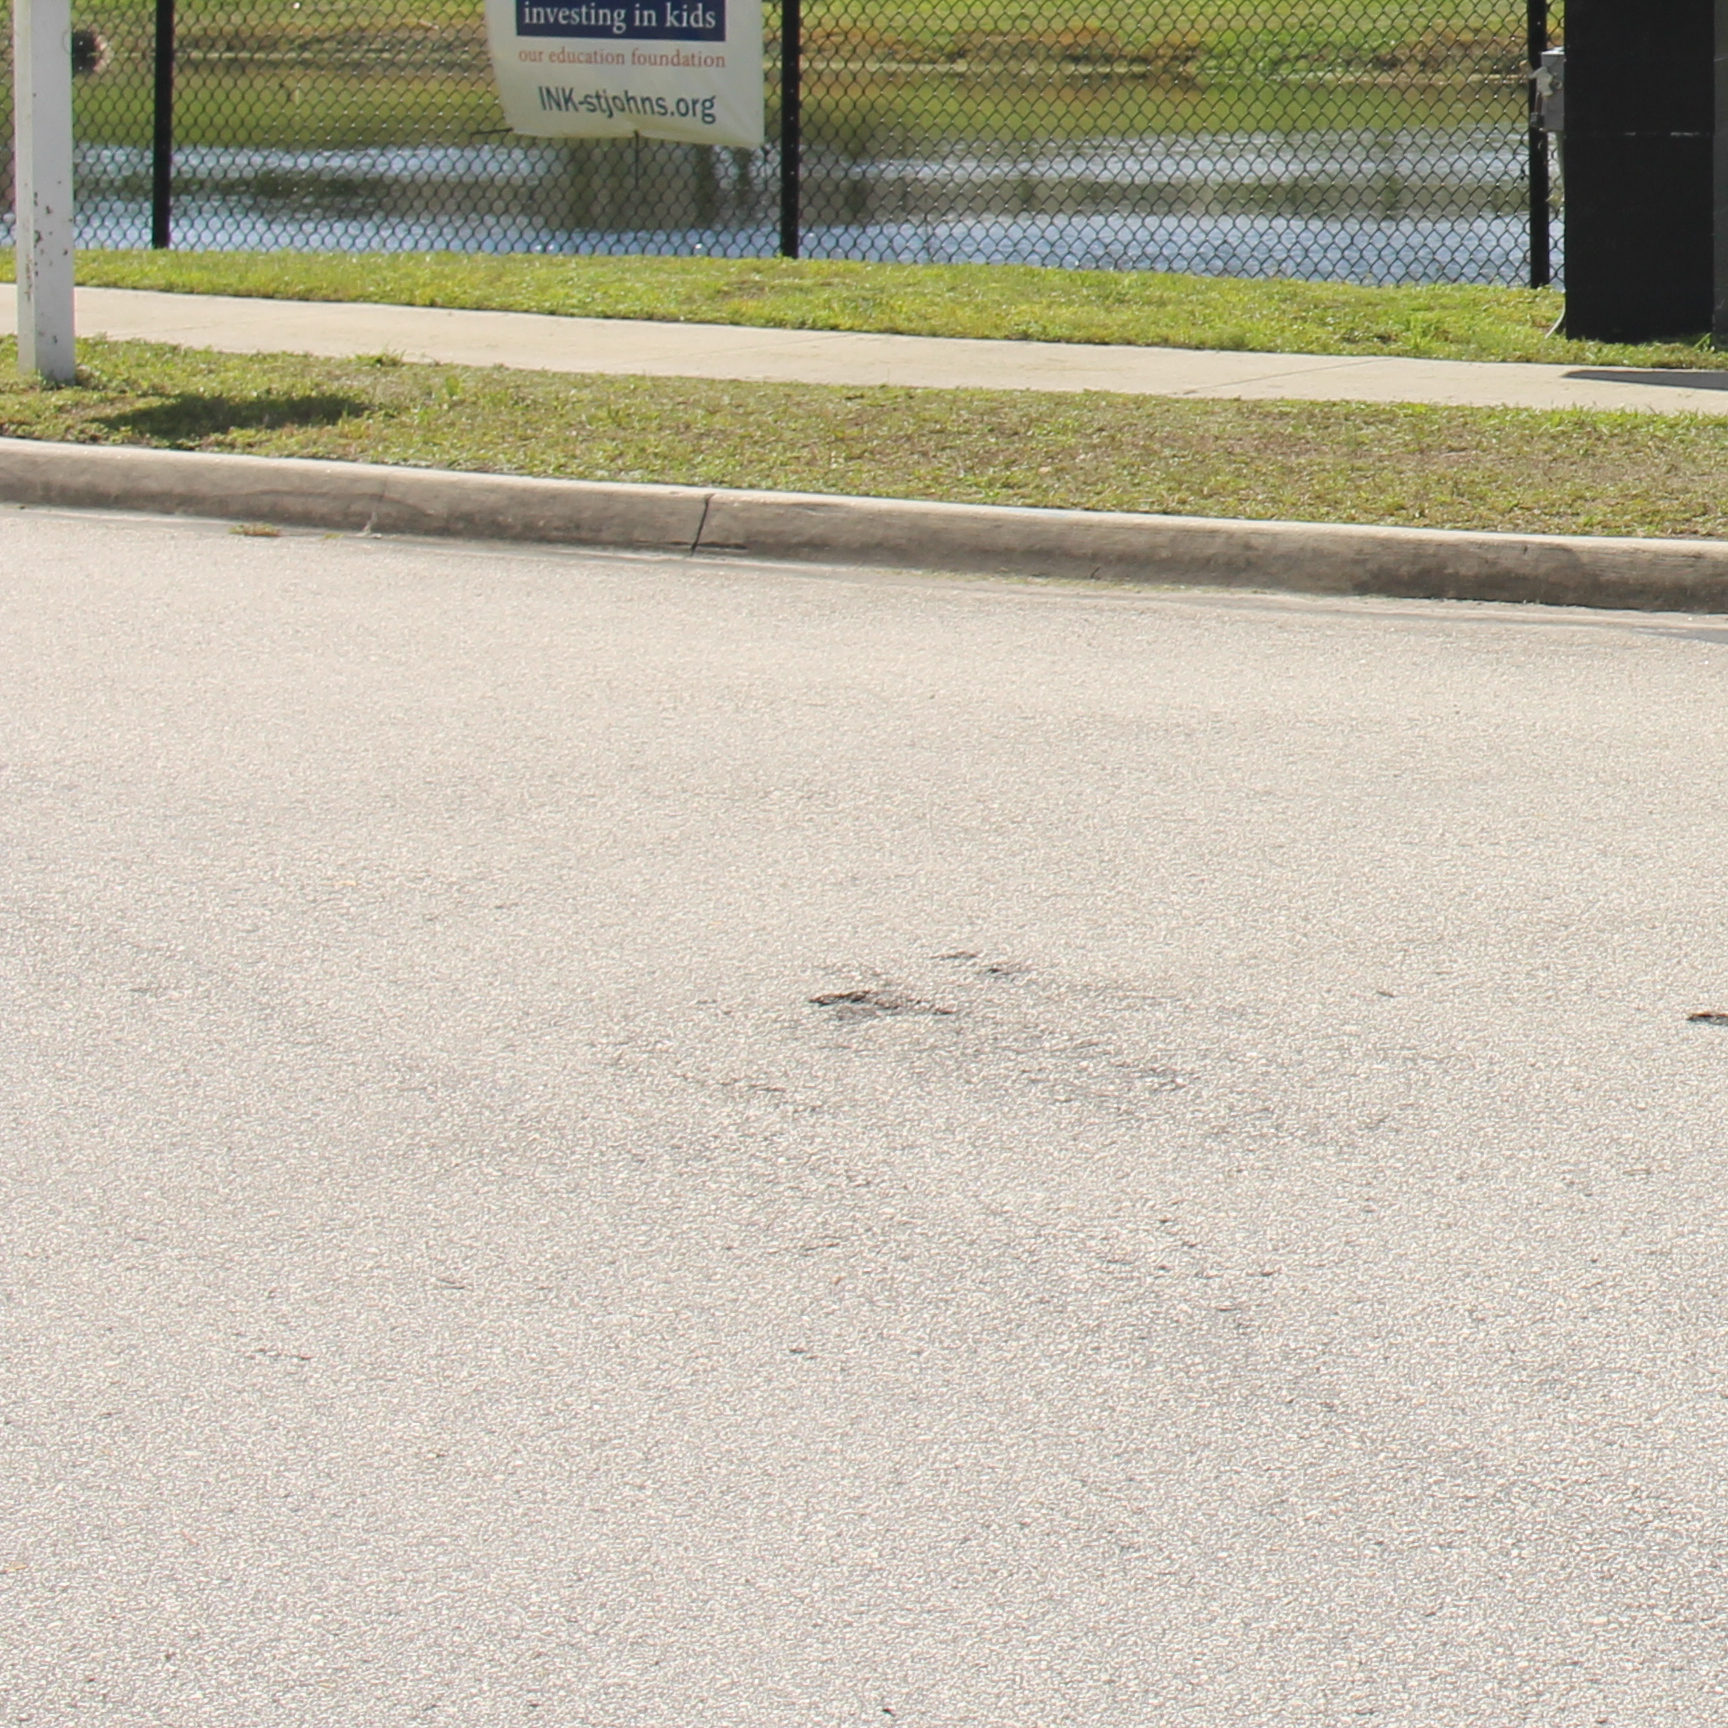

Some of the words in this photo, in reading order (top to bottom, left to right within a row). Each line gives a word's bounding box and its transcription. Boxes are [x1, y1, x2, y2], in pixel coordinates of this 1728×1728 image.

[523, 0, 627, 35] investing
[634, 3, 657, 27] in
[665, 2, 716, 29] kids
[518, 48, 544, 63] our
[549, 46, 626, 65] education
[630, 47, 726, 68] foundation
[538, 85, 717, 124] INK-stjohns.org
